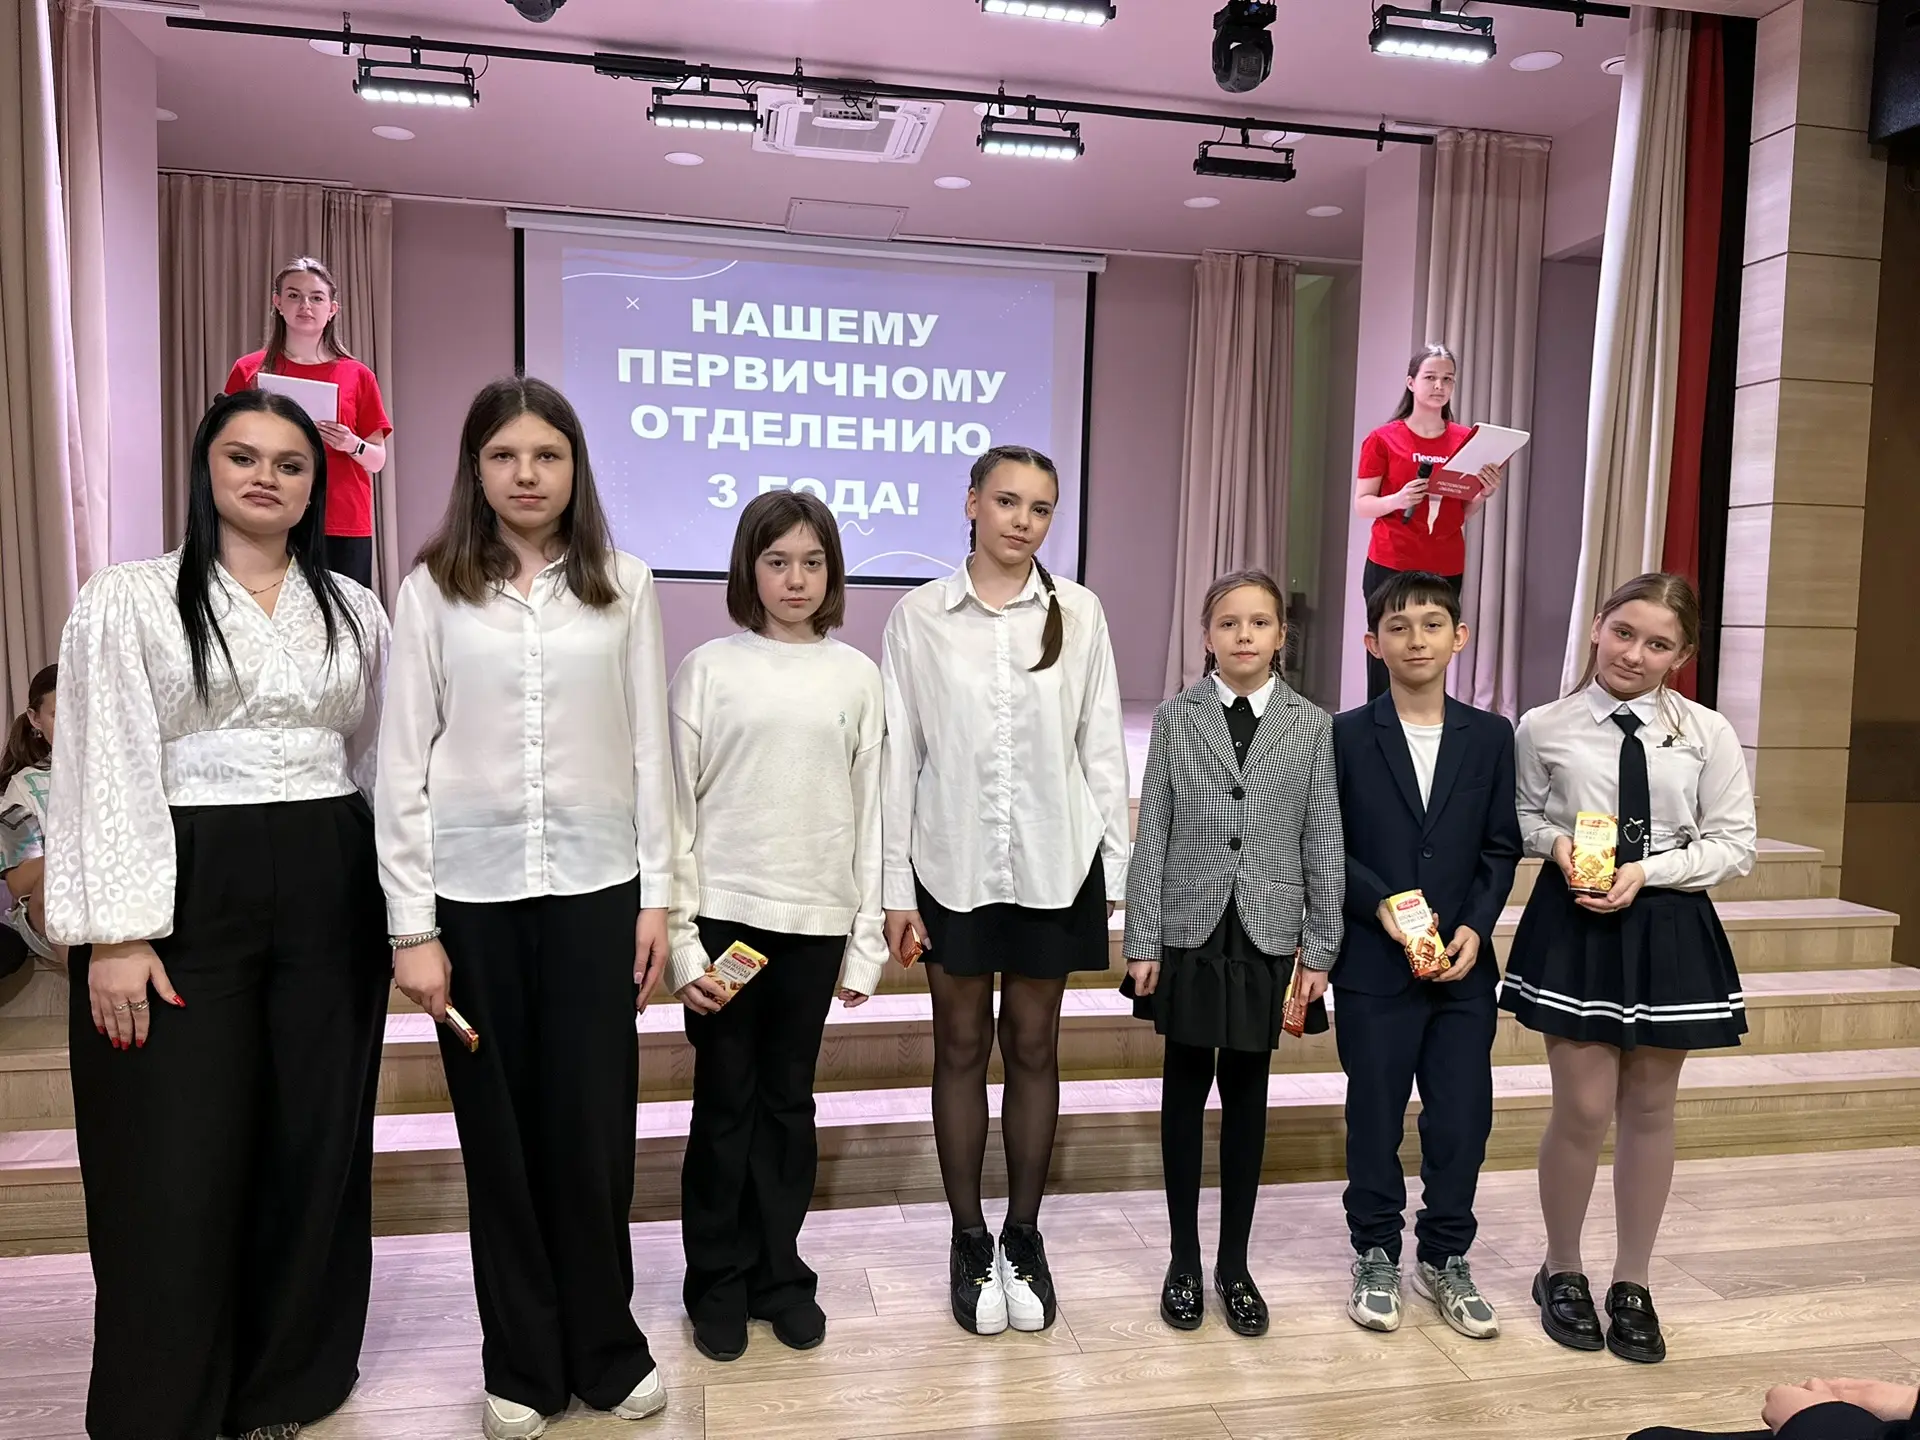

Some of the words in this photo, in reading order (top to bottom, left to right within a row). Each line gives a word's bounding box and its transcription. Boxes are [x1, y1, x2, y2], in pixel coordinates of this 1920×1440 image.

[692, 298, 939, 347] НАШЕМУ
[617, 348, 1006, 404] ПЕРВИЧНОМУ
[630, 404, 991, 456] ОТДЕЛЕНИЮ
[1412, 453, 1449, 464] Первы
